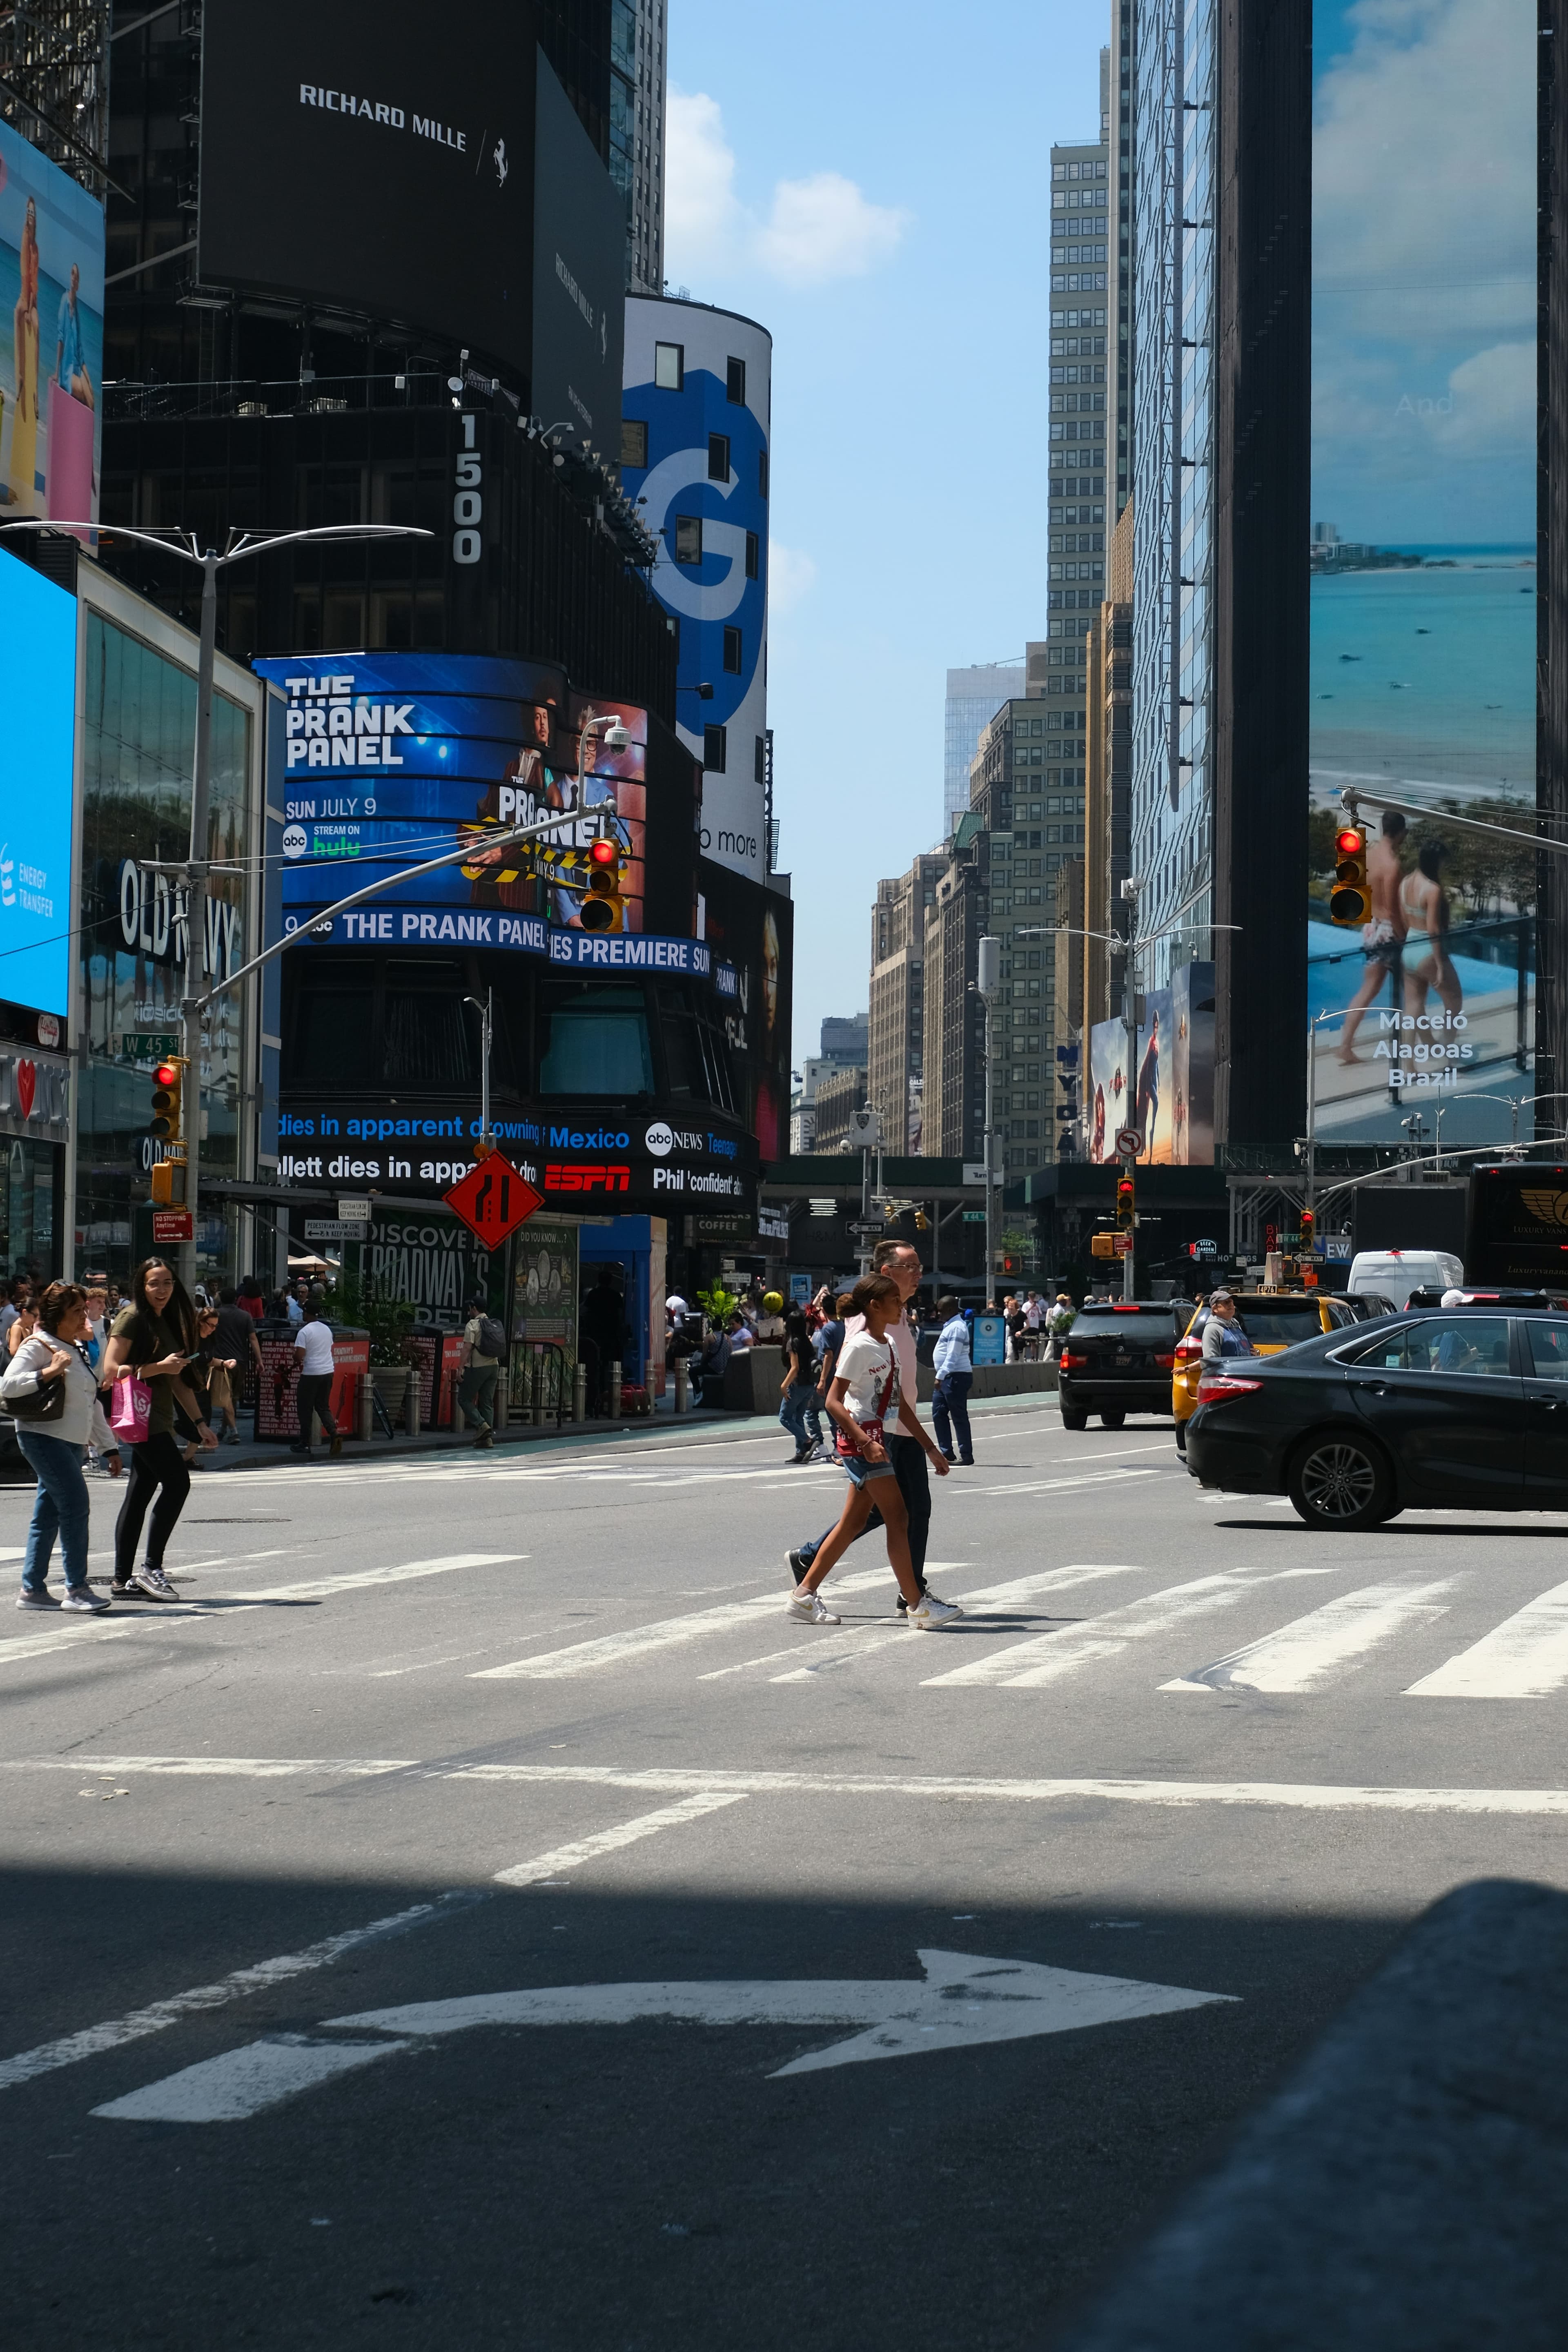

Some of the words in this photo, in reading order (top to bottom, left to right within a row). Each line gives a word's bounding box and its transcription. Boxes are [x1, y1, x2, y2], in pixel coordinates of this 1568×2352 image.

[301, 84, 404, 129] RICHARD
[413, 114, 466, 152] MILLE
[556, 252, 577, 304] RICHARD
[578, 289, 593, 328] MILLE
[453, 415, 482, 564] 1500
[634, 448, 747, 621] G
[285, 675, 354, 707] THE
[287, 705, 415, 737] PRANK
[287, 736, 403, 768] PANEL
[287, 801, 315, 819] SUN
[321, 798, 357, 817] JULY
[364, 798, 376, 815] 9
[284, 835, 305, 846] abc
[314, 826, 346, 835] STREAM
[348, 826, 360, 835] ON
[314, 837, 360, 856] hulu
[718, 831, 756, 858] more
[19, 862, 47, 891] ENERGY
[19, 889, 53, 919] TRANSFER
[121, 859, 169, 956] OLD
[176, 881, 236, 979] NVY
[343, 913, 393, 938] THE
[402, 914, 492, 942] PRANK
[499, 918, 545, 949] PANEL
[578, 939, 687, 968] PREMIERE
[693, 947, 710, 973] SUN
[716, 967, 735, 994] PRANK
[1380, 1009, 1468, 1030] Maceió
[127, 1037, 138, 1052] W
[145, 1038, 162, 1053] 45
[169, 1038, 177, 1048] St
[1373, 1040, 1473, 1062] Alagoas
[1389, 1067, 1457, 1087] Brazil
[278, 1114, 314, 1134] dies
[321, 1114, 339, 1135] in
[347, 1116, 463, 1140] apparent
[470, 1116, 539, 1144] downing
[550, 1127, 629, 1149] Mexico
[648, 1132, 671, 1145] abc
[673, 1132, 702, 1151] NEWS
[143, 1137, 161, 1171] OLD
[328, 1156, 380, 1178] dies
[388, 1156, 411, 1178] in
[544, 1165, 630, 1192] ESPN
[653, 1168, 684, 1191] Phil
[687, 1170, 732, 1195] 'confident'
[521, 1232, 530, 1242] DID
[530, 1232, 541, 1242] YOU
[699, 1221, 738, 1231] COFFEE
[868, 1364, 886, 1375] New
